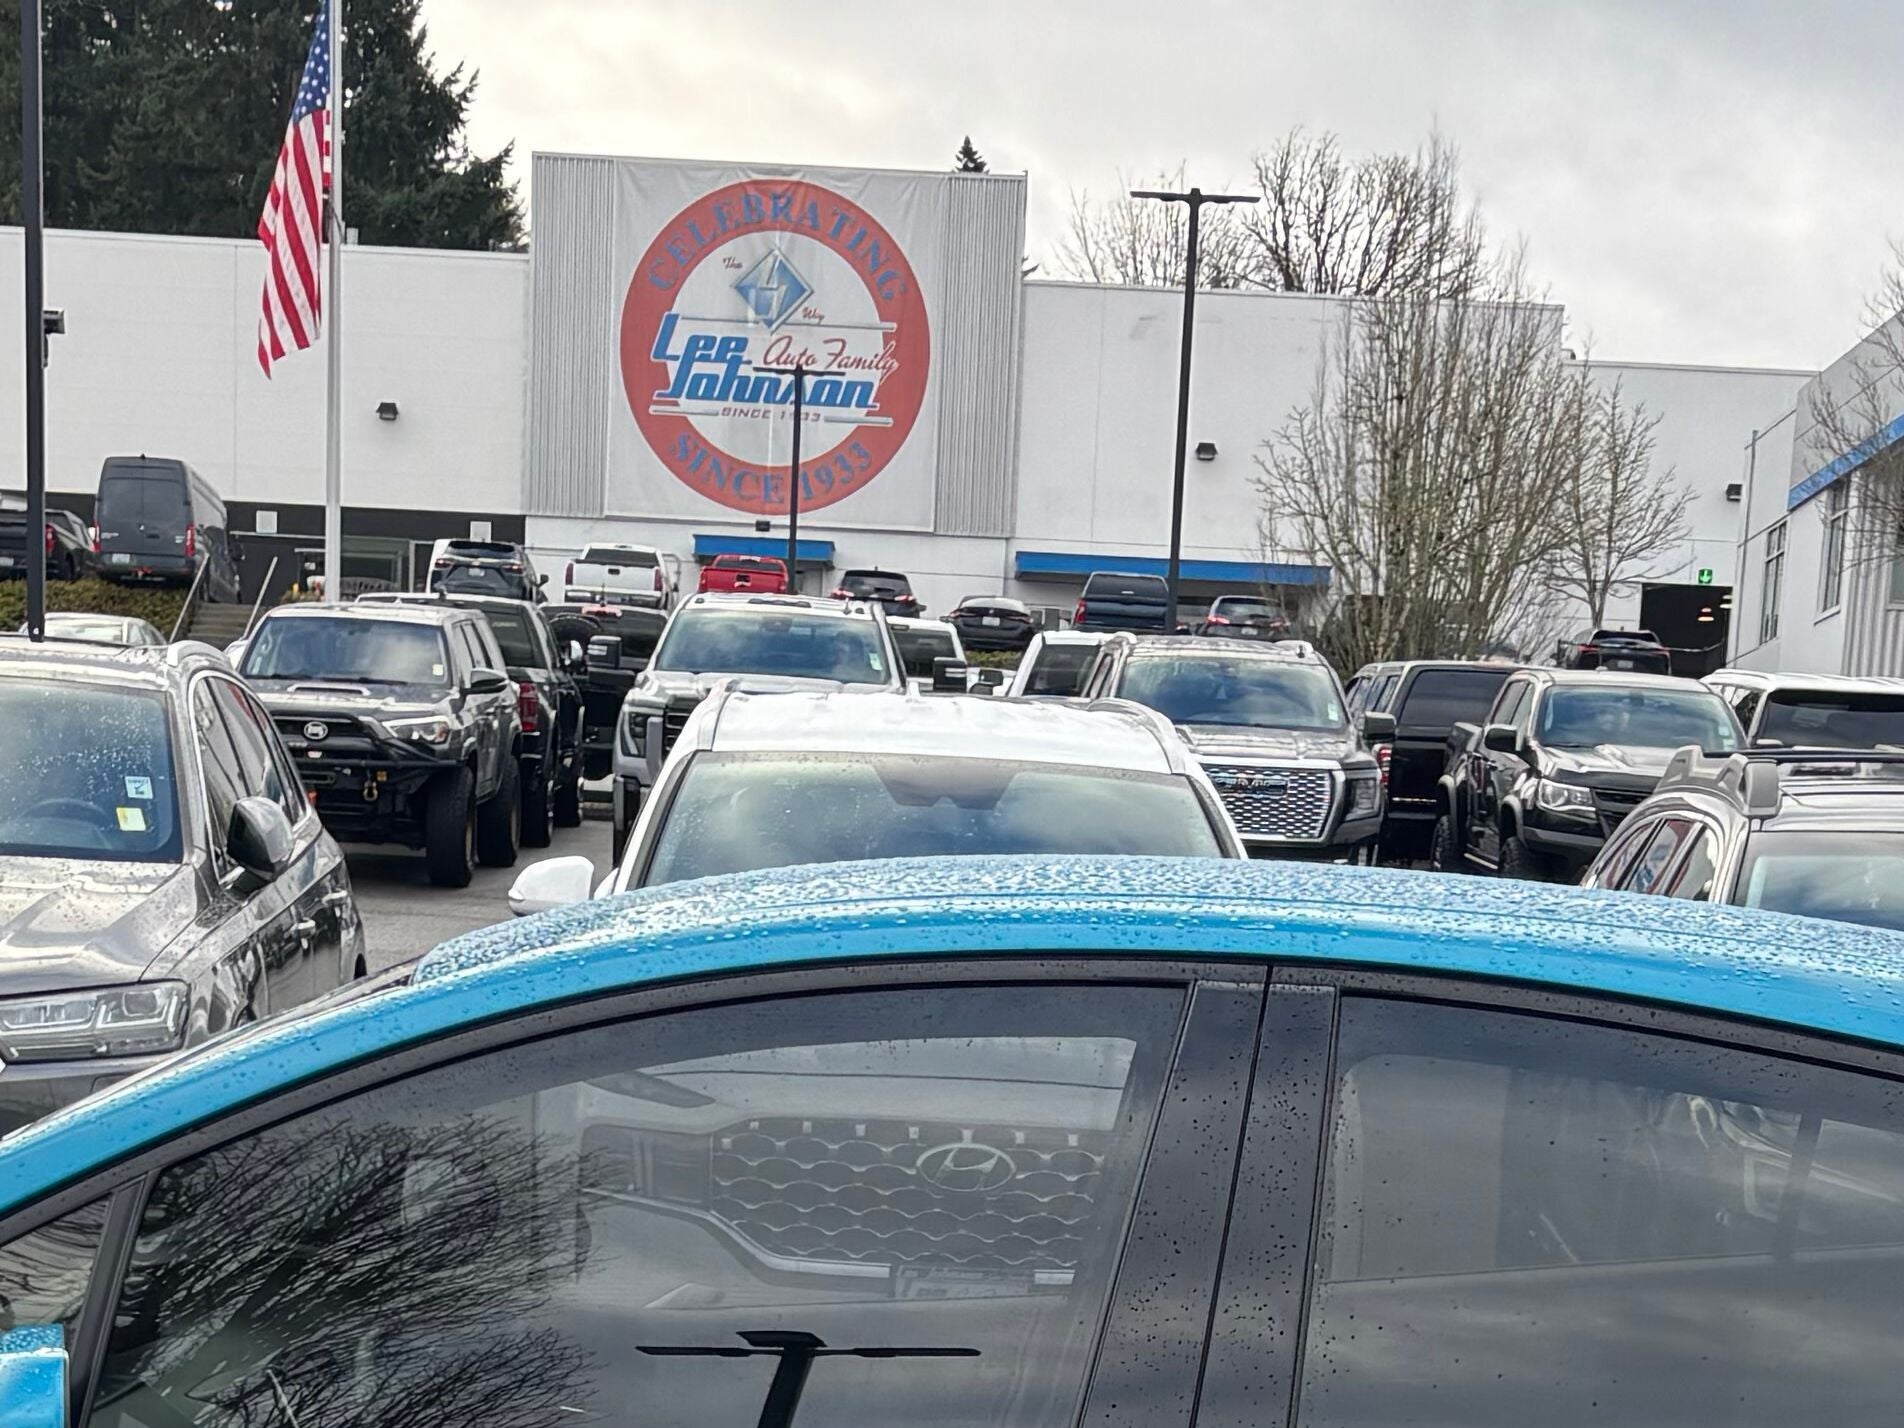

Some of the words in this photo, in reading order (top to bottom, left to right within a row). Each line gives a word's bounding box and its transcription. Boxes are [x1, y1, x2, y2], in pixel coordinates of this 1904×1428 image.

[648, 190, 907, 300] CELEBRATING
[723, 256, 743, 269] The
[652, 312, 753, 365] Lee
[763, 335, 817, 366] Auto
[823, 338, 899, 385] Family
[669, 432, 785, 505] SINCE
[799, 441, 873, 501] 1933
